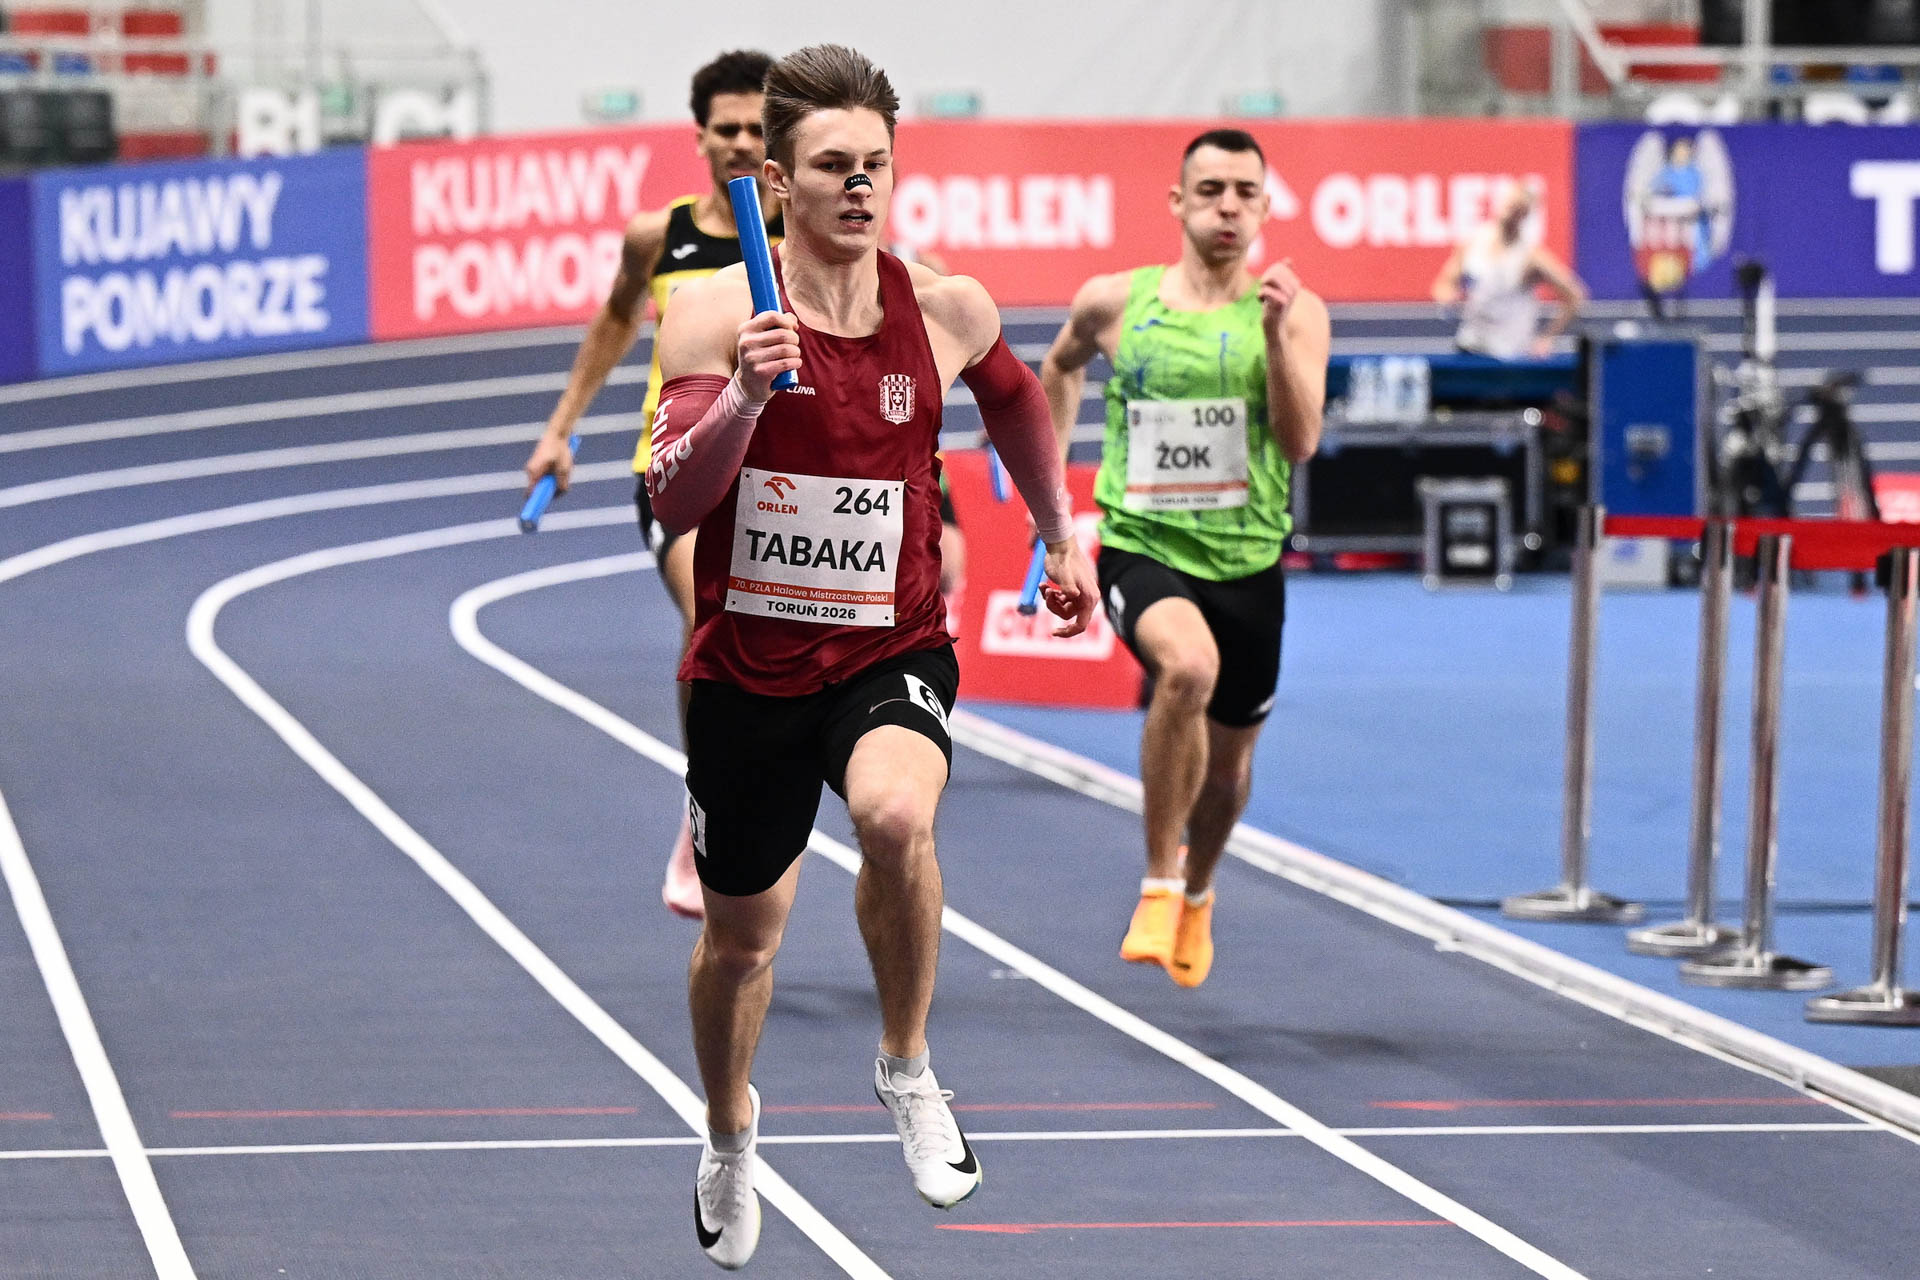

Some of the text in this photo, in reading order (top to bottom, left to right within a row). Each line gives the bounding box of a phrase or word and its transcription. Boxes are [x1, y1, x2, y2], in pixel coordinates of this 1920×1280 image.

[410, 145, 650, 236] KUJAWY
[59, 170, 282, 267] KUJAWY
[891, 173, 1115, 249] ORLEN
[412, 230, 625, 322] POMOR
[62, 254, 330, 355] POMORZE
[1193, 407, 1236, 428] 100
[1155, 440, 1212, 470] ŻOK
[756, 500, 798, 515] ORLEN
[833, 486, 890, 516] 264
[745, 529, 886, 572] TABAKA
[735, 579, 888, 603] 70. PZLA Halowe Mistrzostwa Polski
[766, 600, 857, 620] TORUŃ 2026
[919, 685, 943, 720] 6
